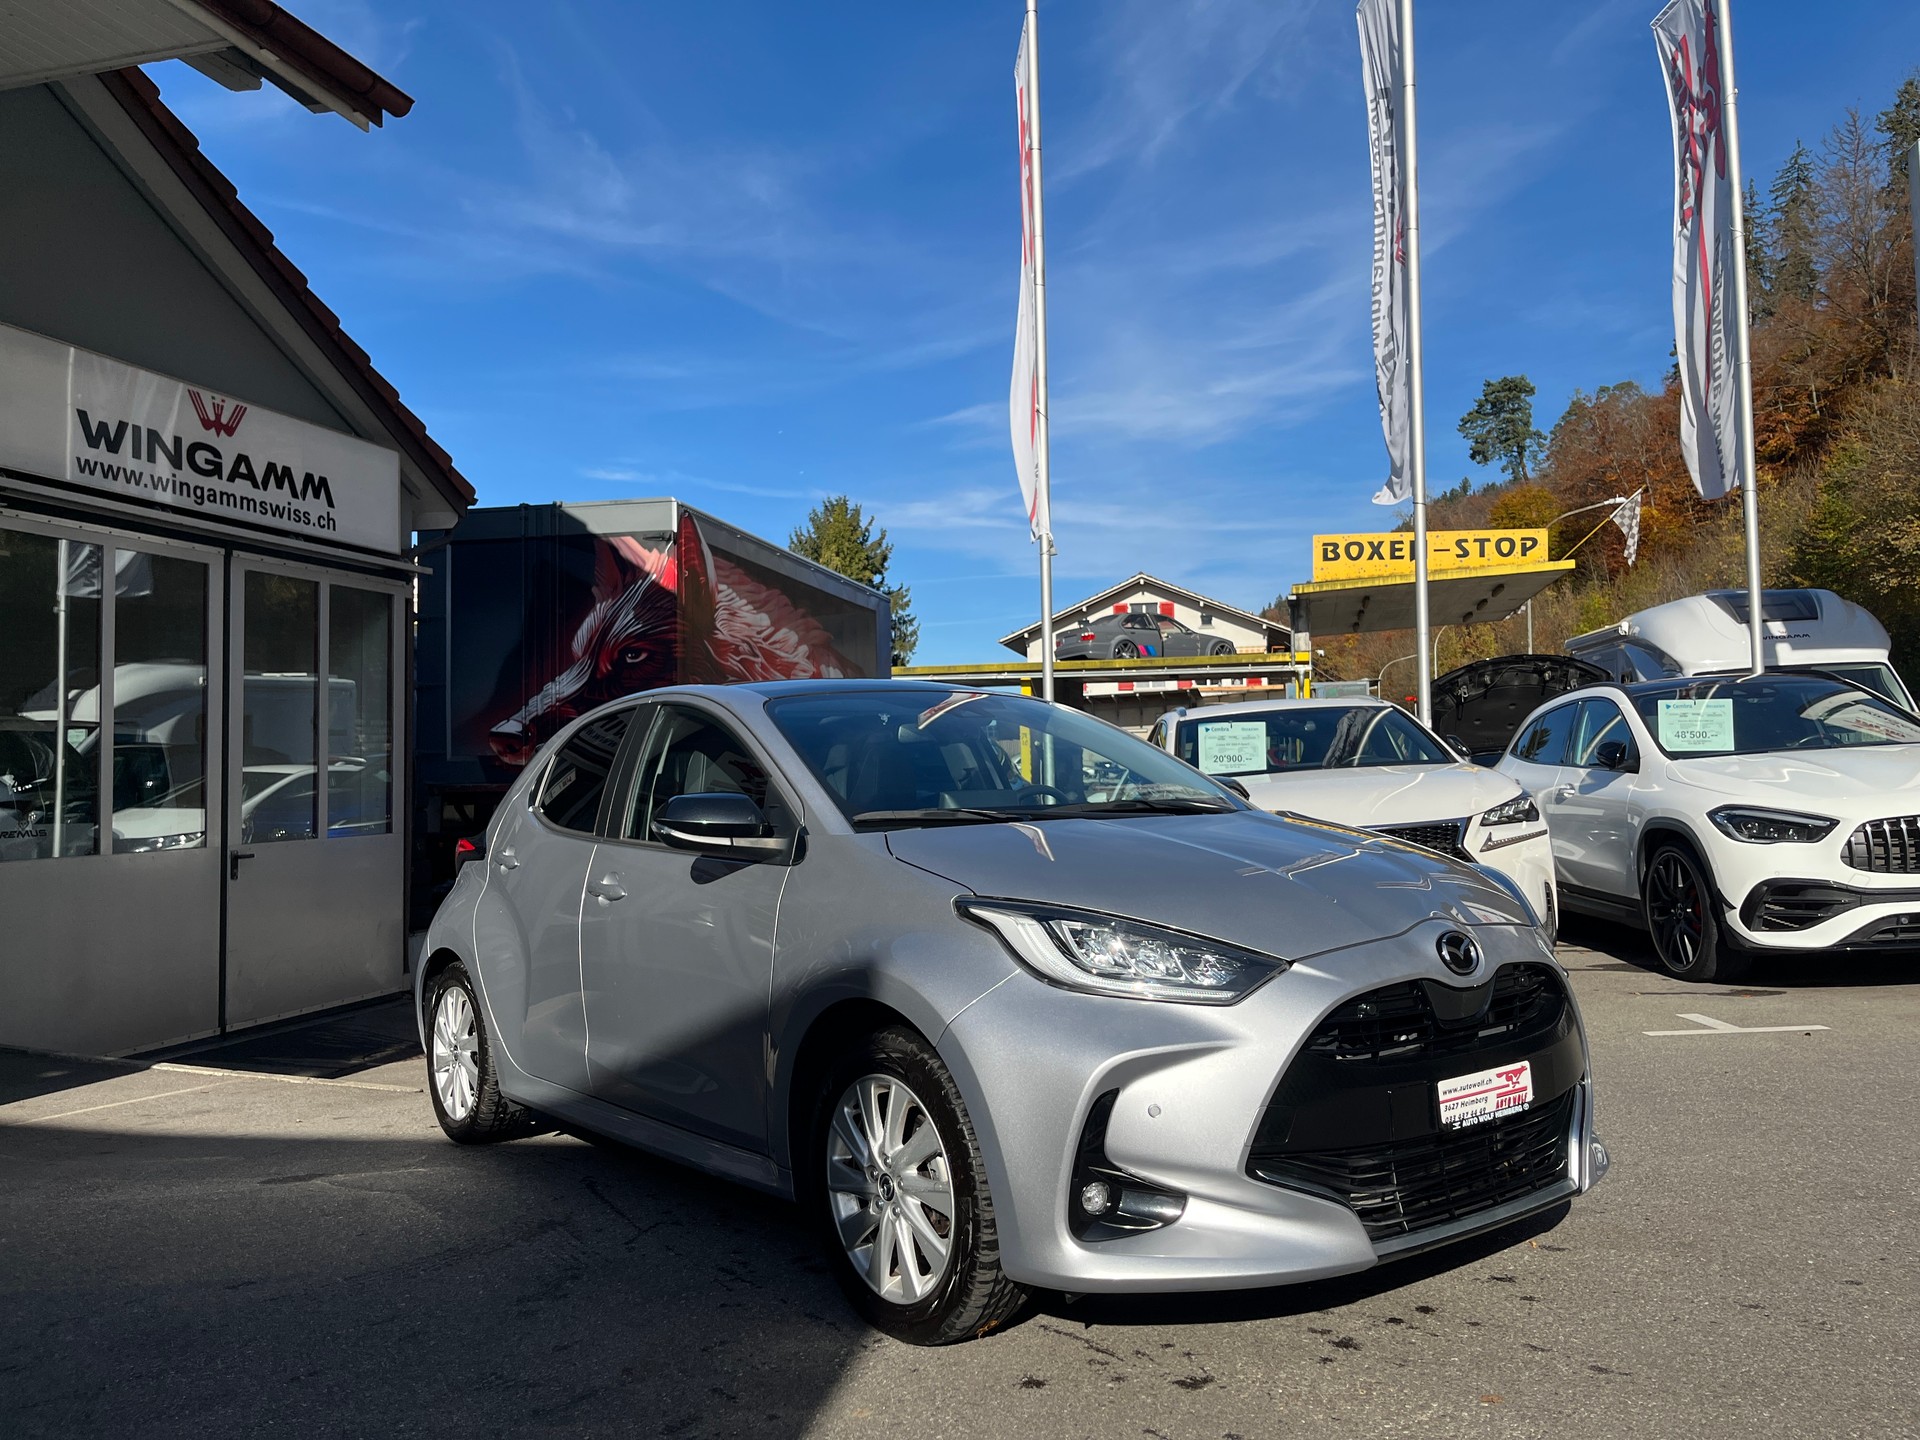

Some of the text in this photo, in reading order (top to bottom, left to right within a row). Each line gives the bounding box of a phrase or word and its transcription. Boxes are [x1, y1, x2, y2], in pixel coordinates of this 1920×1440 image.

[76, 408, 336, 509] WINGAMM
[76, 456, 337, 532] www.wingammswiss.ch
[0, 829, 48, 839] REMUS
[1442, 1078, 1493, 1096] www.autowolf.ch
[1444, 1095, 1489, 1113] 3627 Heimberg
[1462, 1117, 1478, 1128] AUTO
[1479, 1112, 1495, 1123] WOLF
